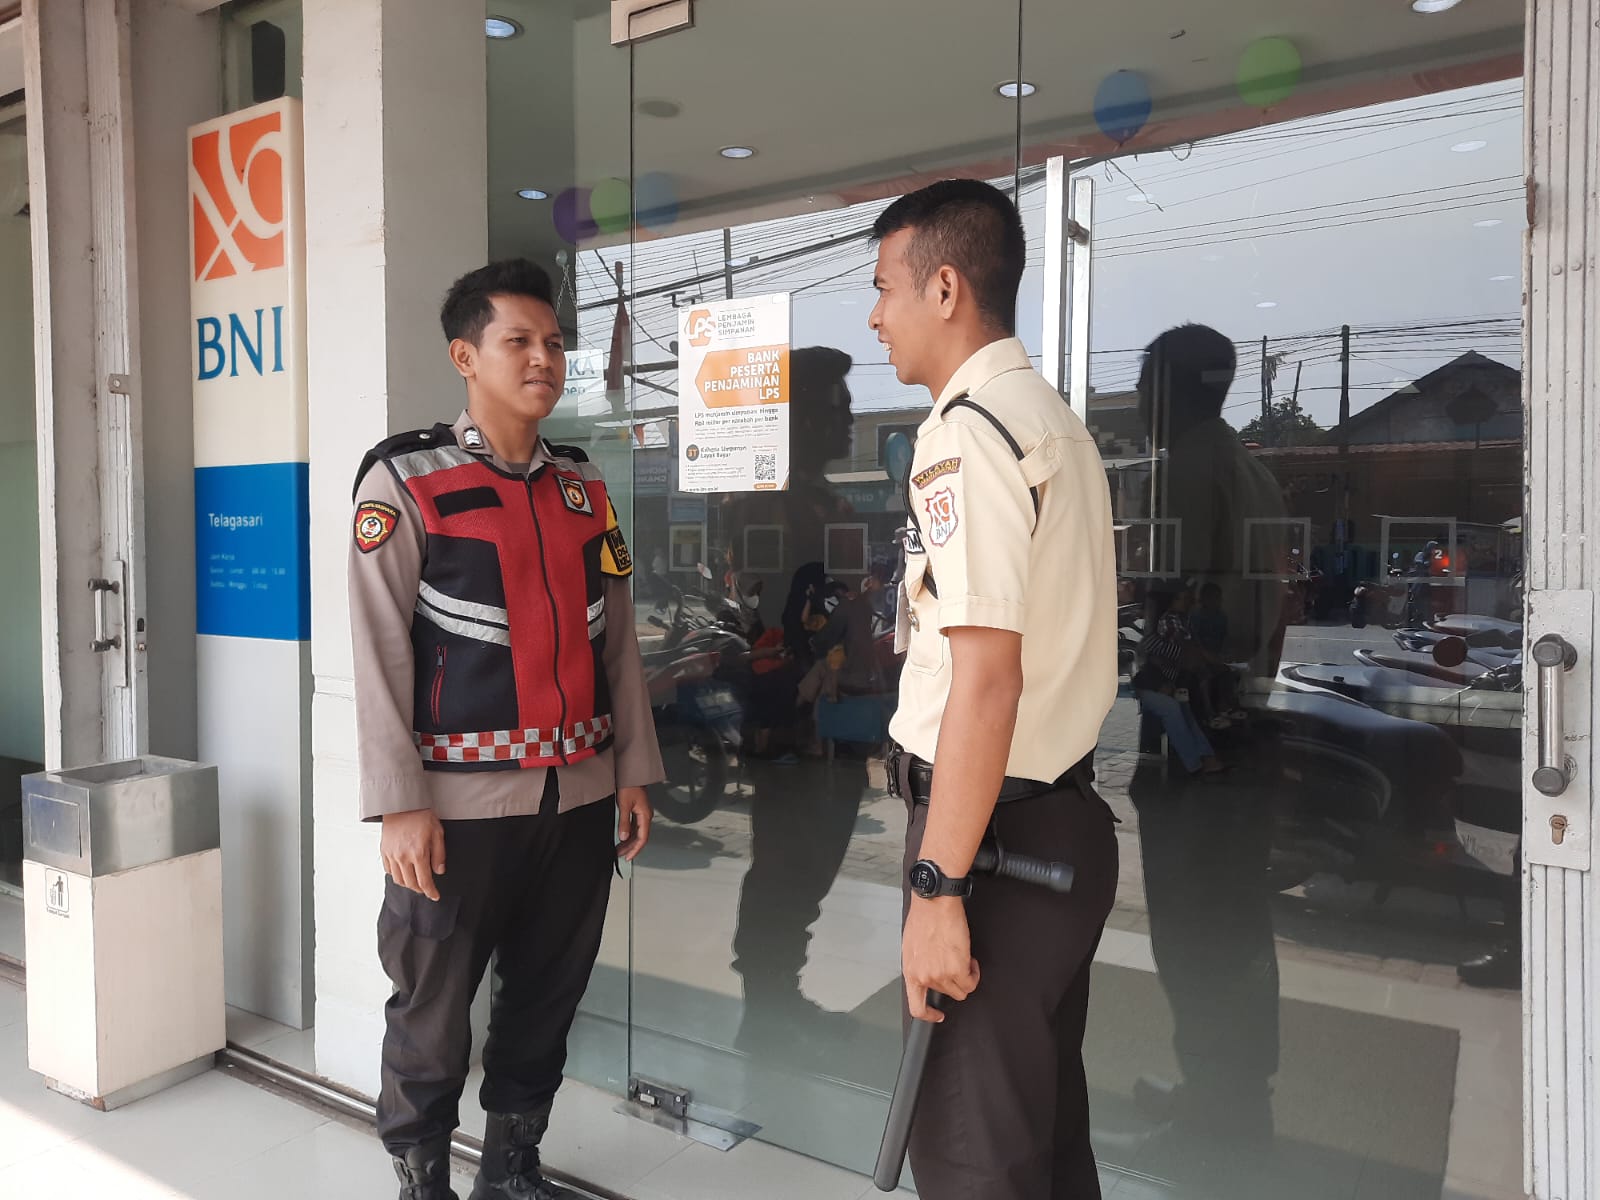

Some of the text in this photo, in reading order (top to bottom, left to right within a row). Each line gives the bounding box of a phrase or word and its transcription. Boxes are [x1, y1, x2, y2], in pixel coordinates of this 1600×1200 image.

[717, 311, 752, 322] LEMBAGA
[717, 319, 755, 329] PENJAMIN
[685, 316, 716, 340] LPS
[717, 326, 755, 336] SIMPANAN
[195, 305, 284, 381] BNI
[747, 349, 780, 364] BANK
[568, 356, 595, 377] KA
[730, 361, 780, 378] PESERTA
[703, 374, 780, 393] PENJAMINAN
[759, 387, 780, 400] LPS
[208, 513, 263, 531] Telagasari
[936, 522, 951, 540] BNI
